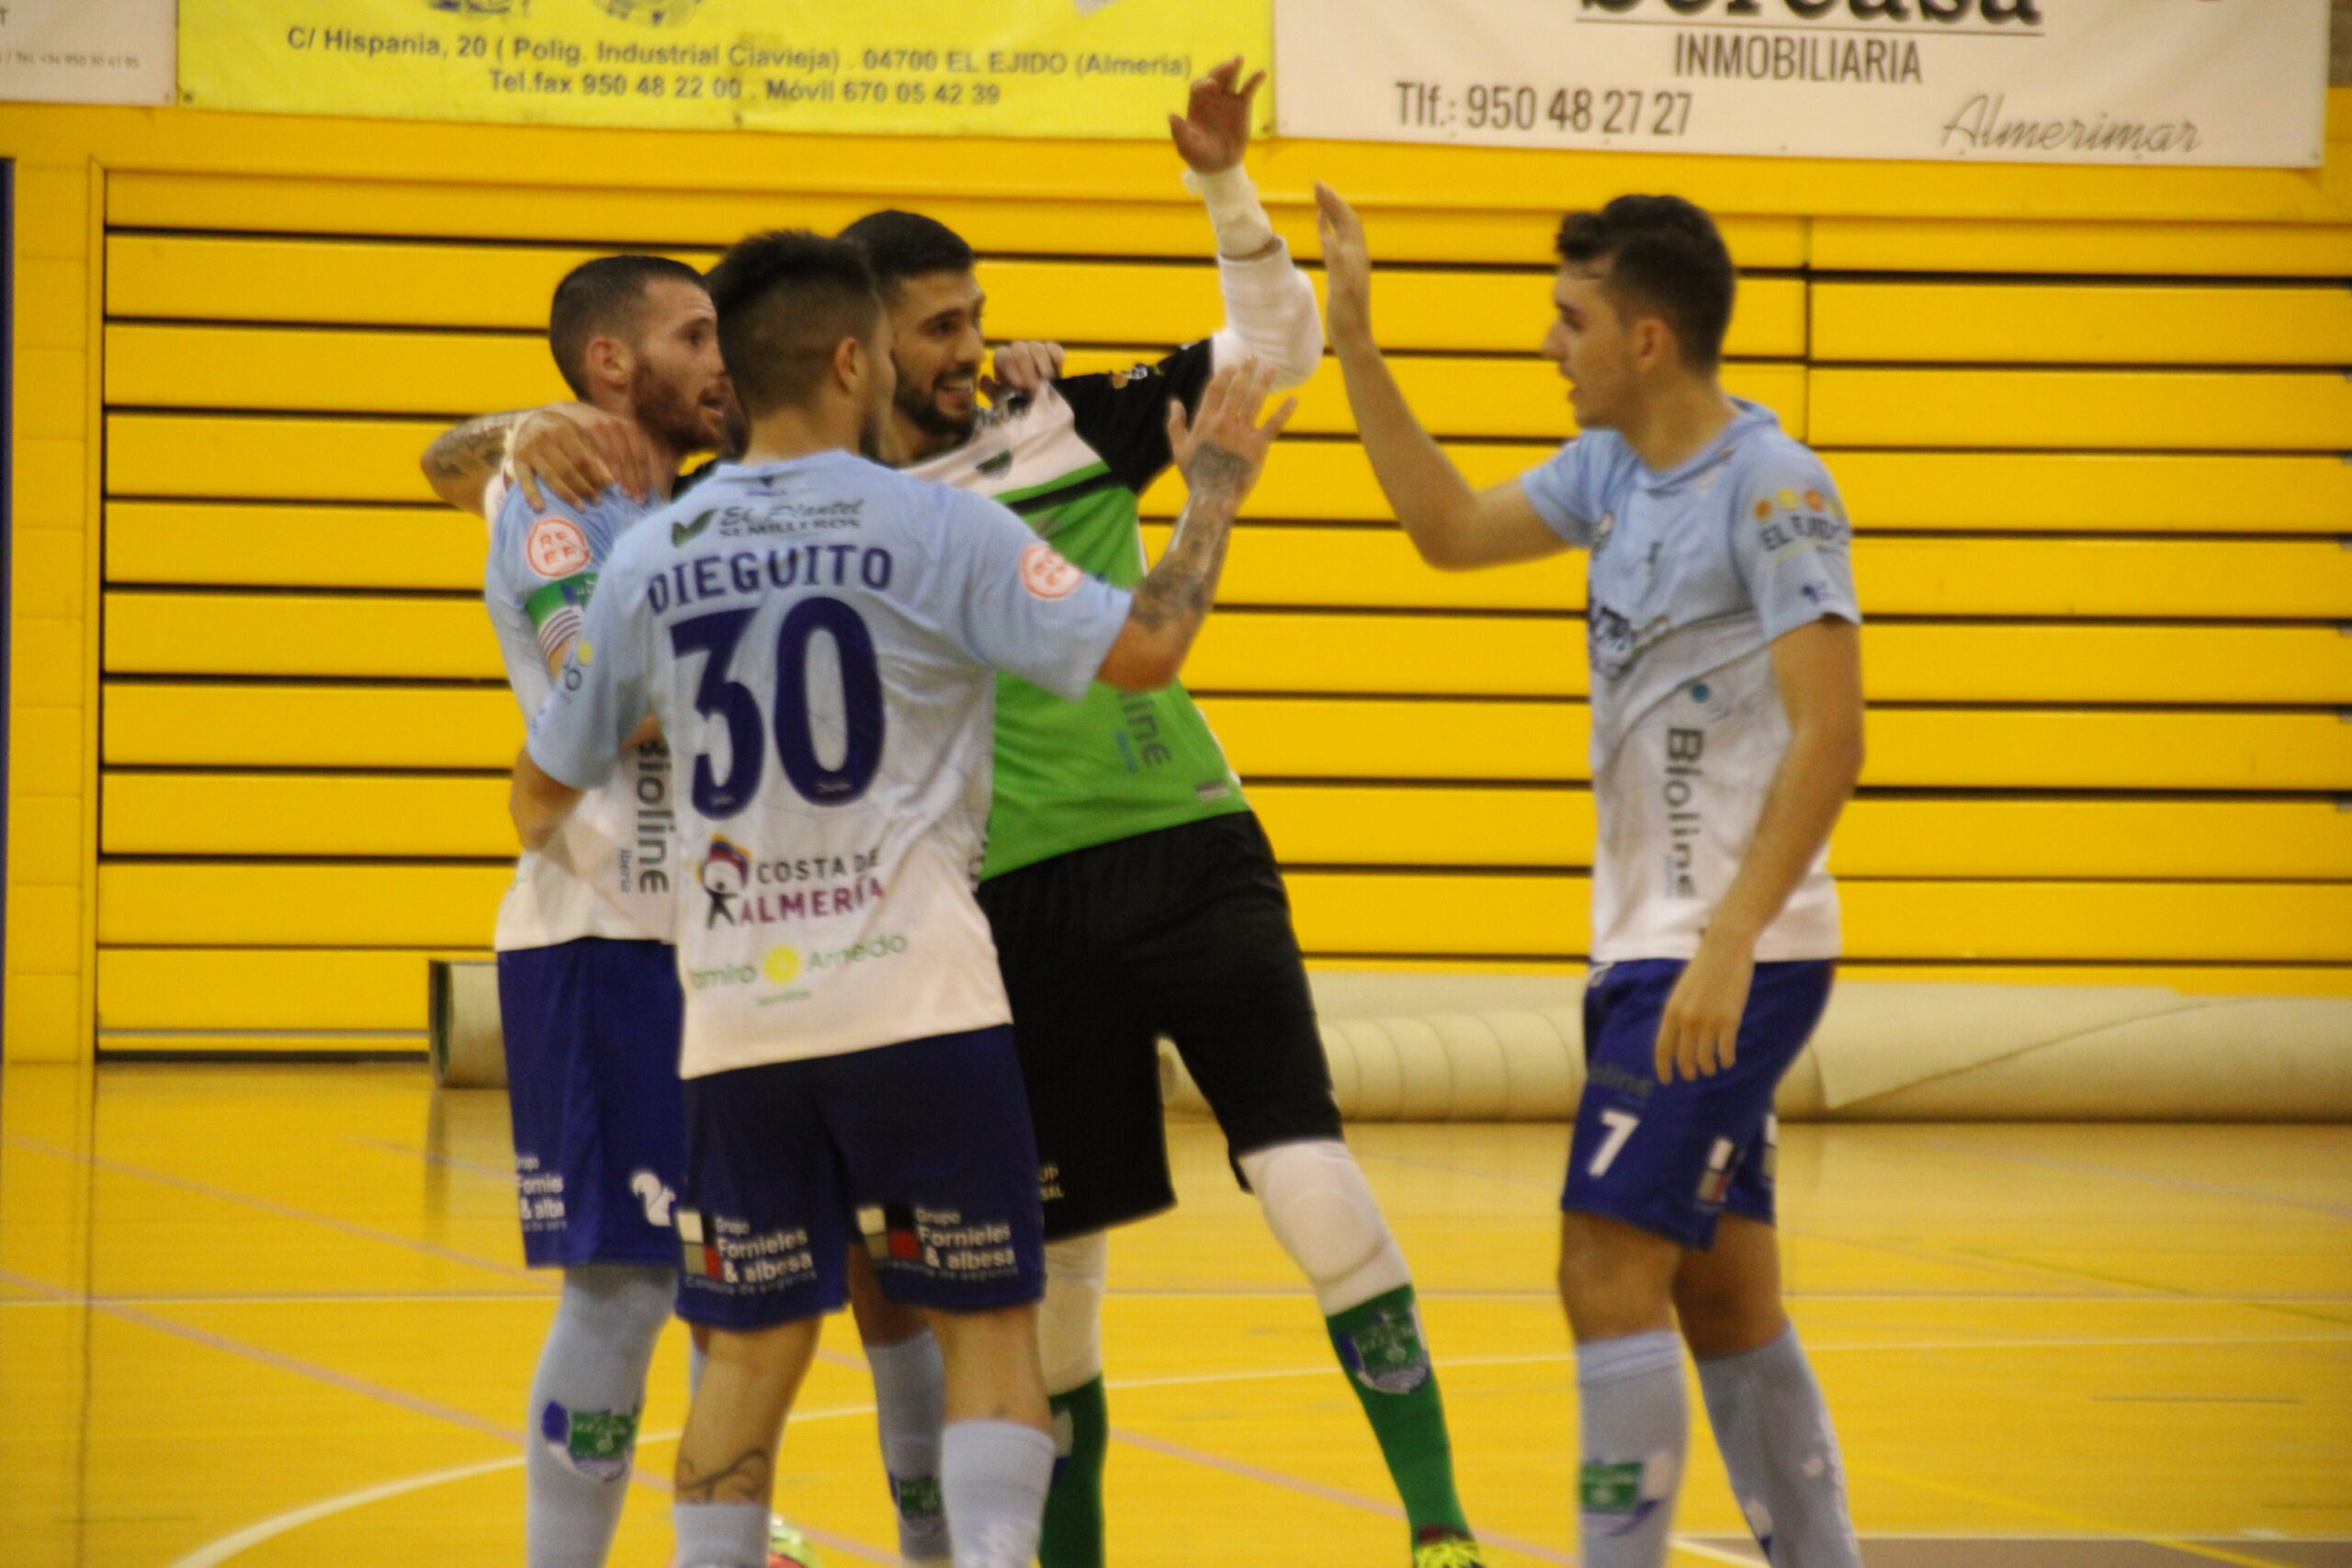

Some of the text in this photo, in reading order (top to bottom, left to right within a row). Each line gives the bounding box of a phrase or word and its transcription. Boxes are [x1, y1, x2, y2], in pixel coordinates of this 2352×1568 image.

[288, 26, 315, 50] C/
[324, 28, 447, 59] Hispania,
[458, 34, 487, 57] 20
[514, 37, 586, 67] Polig.
[597, 41, 719, 65] Industrial
[863, 49, 938, 71] 04700
[947, 51, 979, 73] EL
[989, 51, 1068, 74] EJIDO
[1674, 33, 1923, 84] INMOBILIARIA
[490, 69, 571, 93] Tel.fax
[582, 74, 628, 96] 950
[636, 76, 665, 97] 48
[674, 77, 703, 99] 22
[712, 78, 741, 99] 00
[842, 80, 888, 103] 670
[896, 82, 926, 104] 05
[933, 83, 964, 105] 42
[971, 84, 1001, 105] 39
[1396, 81, 1693, 136] Tlf.: 950 48 27 27
[1939, 92, 2201, 153] Almerimar
[647, 544, 894, 615] DIEGUITO
[670, 596, 887, 820] 30
[756, 847, 880, 885] COSTA DE
[740, 875, 884, 926] ALMERÍA
[1588, 1108, 1640, 1179] 7
[716, 1228, 809, 1258] Fornieles
[743, 1251, 815, 1282] albesa
